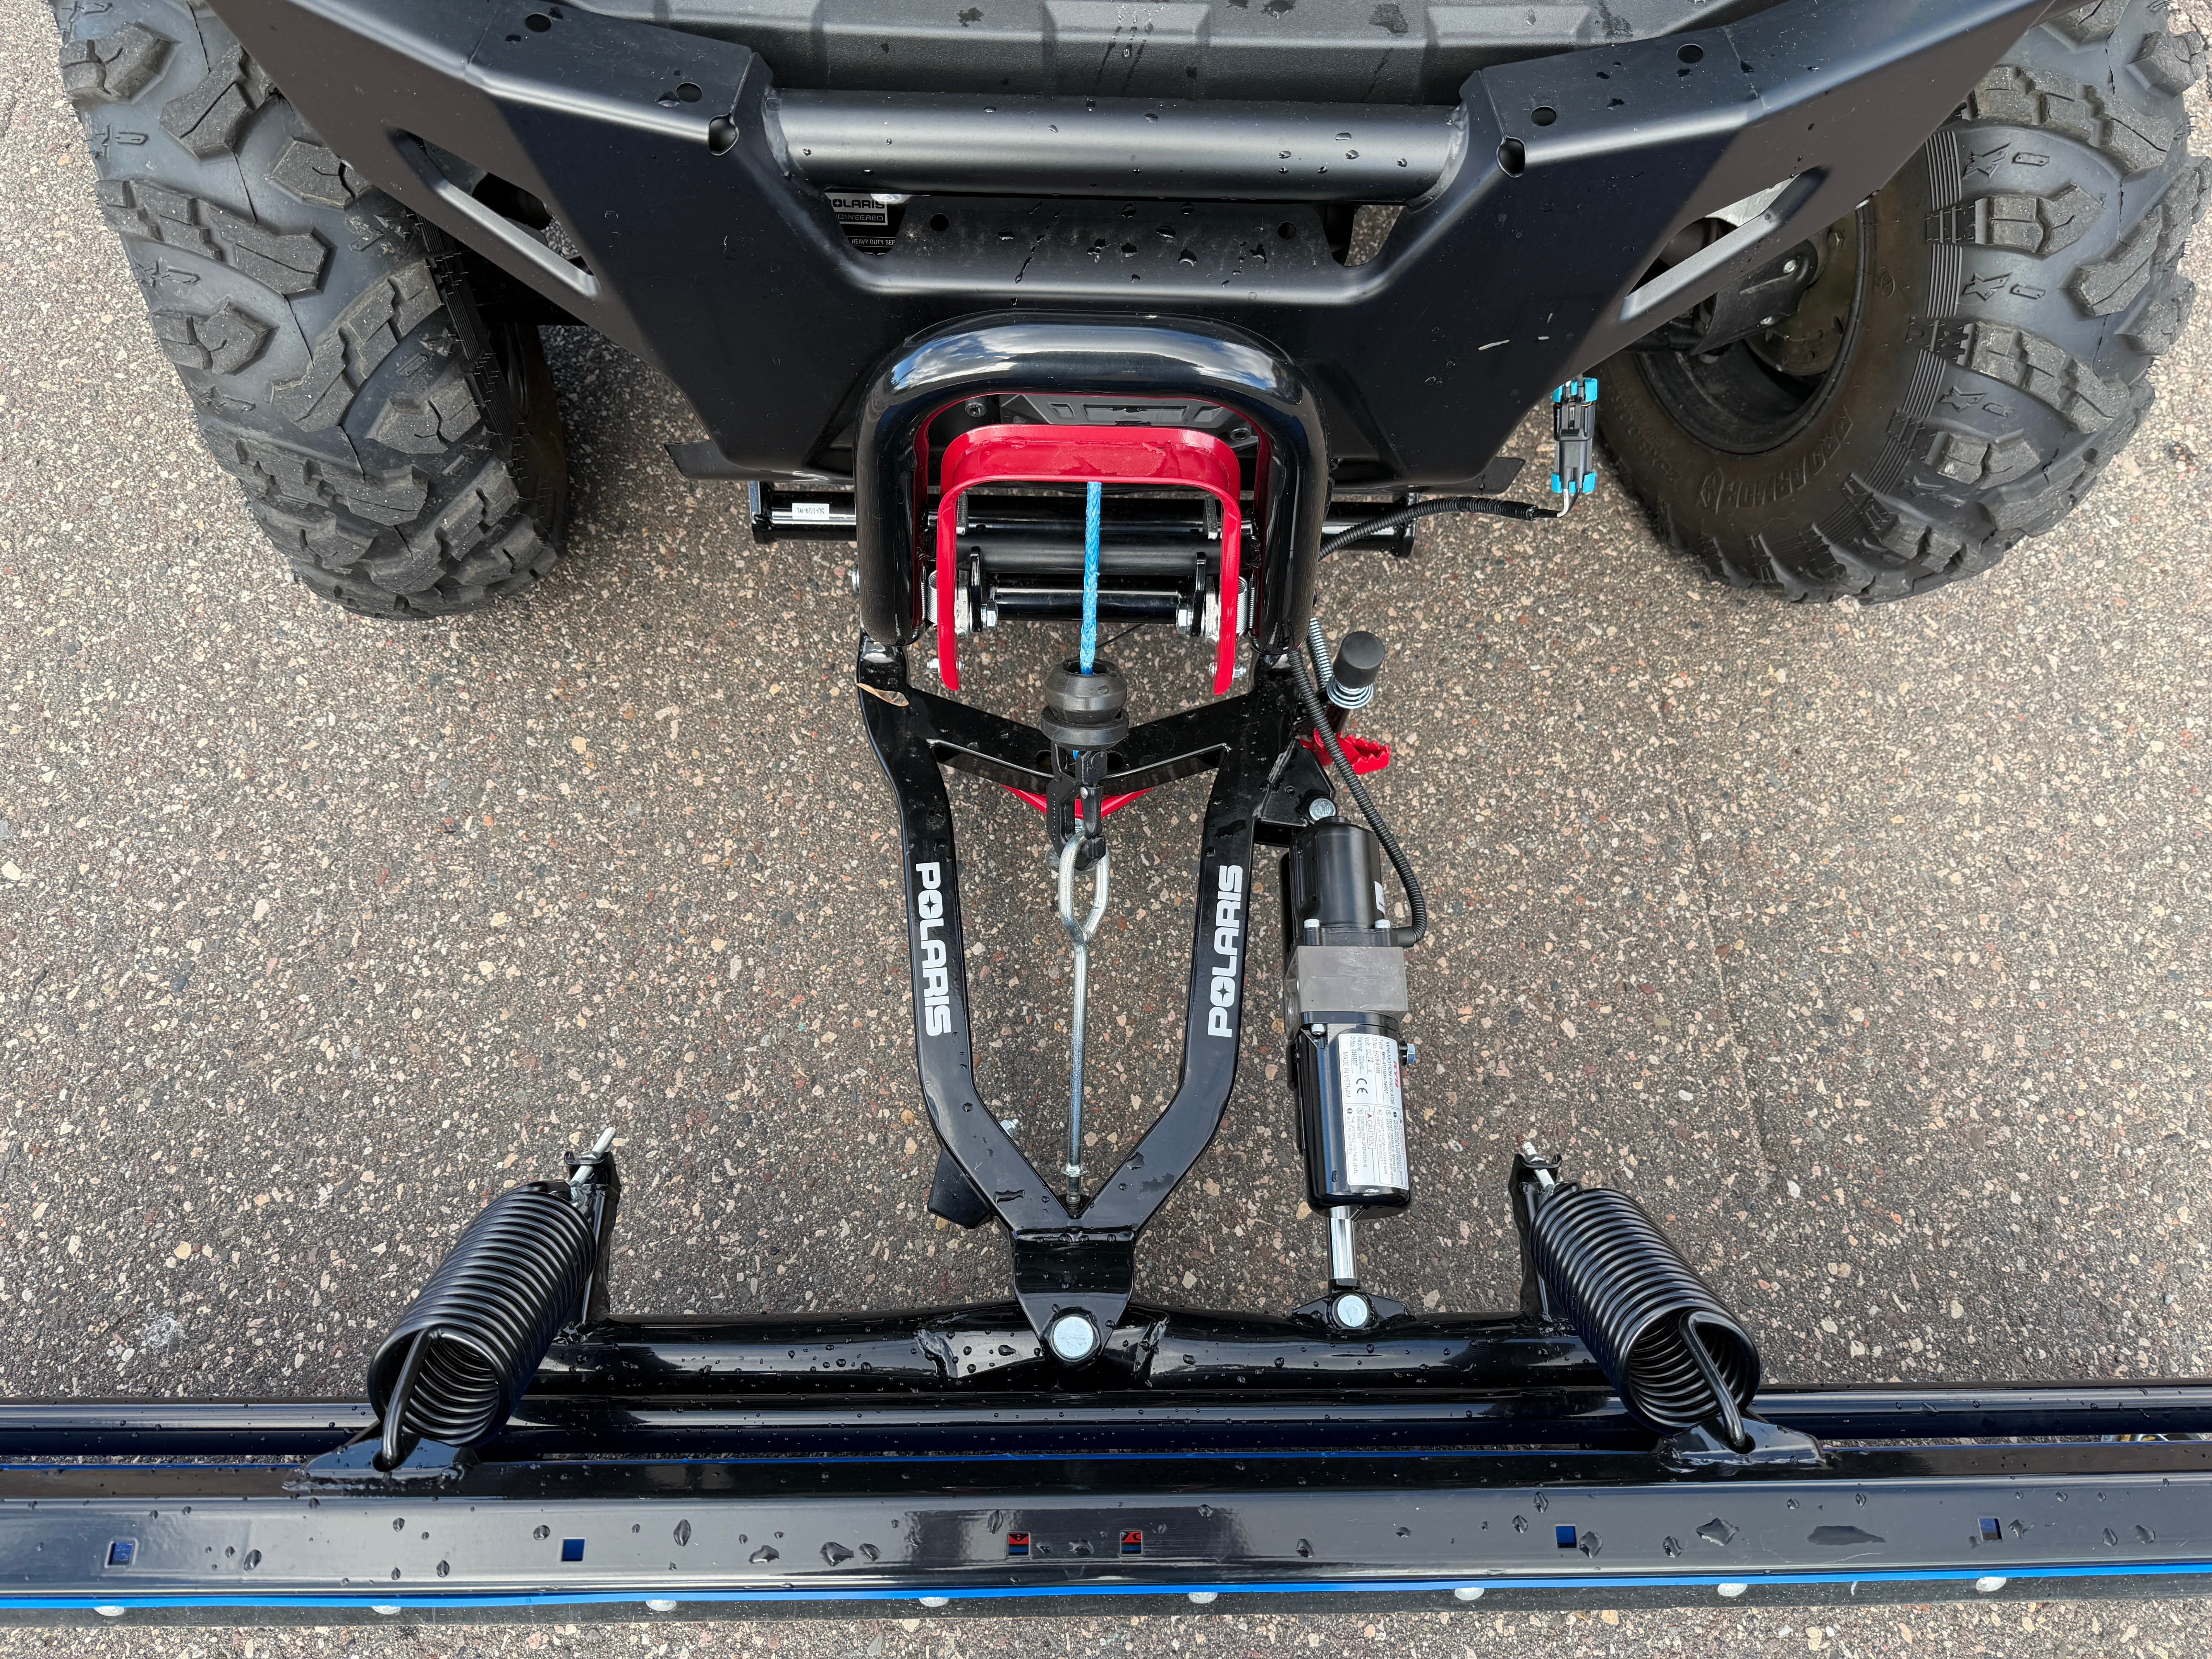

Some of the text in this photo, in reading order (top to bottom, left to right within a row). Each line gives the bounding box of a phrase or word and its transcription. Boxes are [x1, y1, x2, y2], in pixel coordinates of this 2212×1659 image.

[829, 199, 885, 209] OLARIS
[915, 862, 951, 1036] POLARIS
[1207, 865, 1243, 1037] POLARIS
[1356, 1078, 1368, 1094] CE
